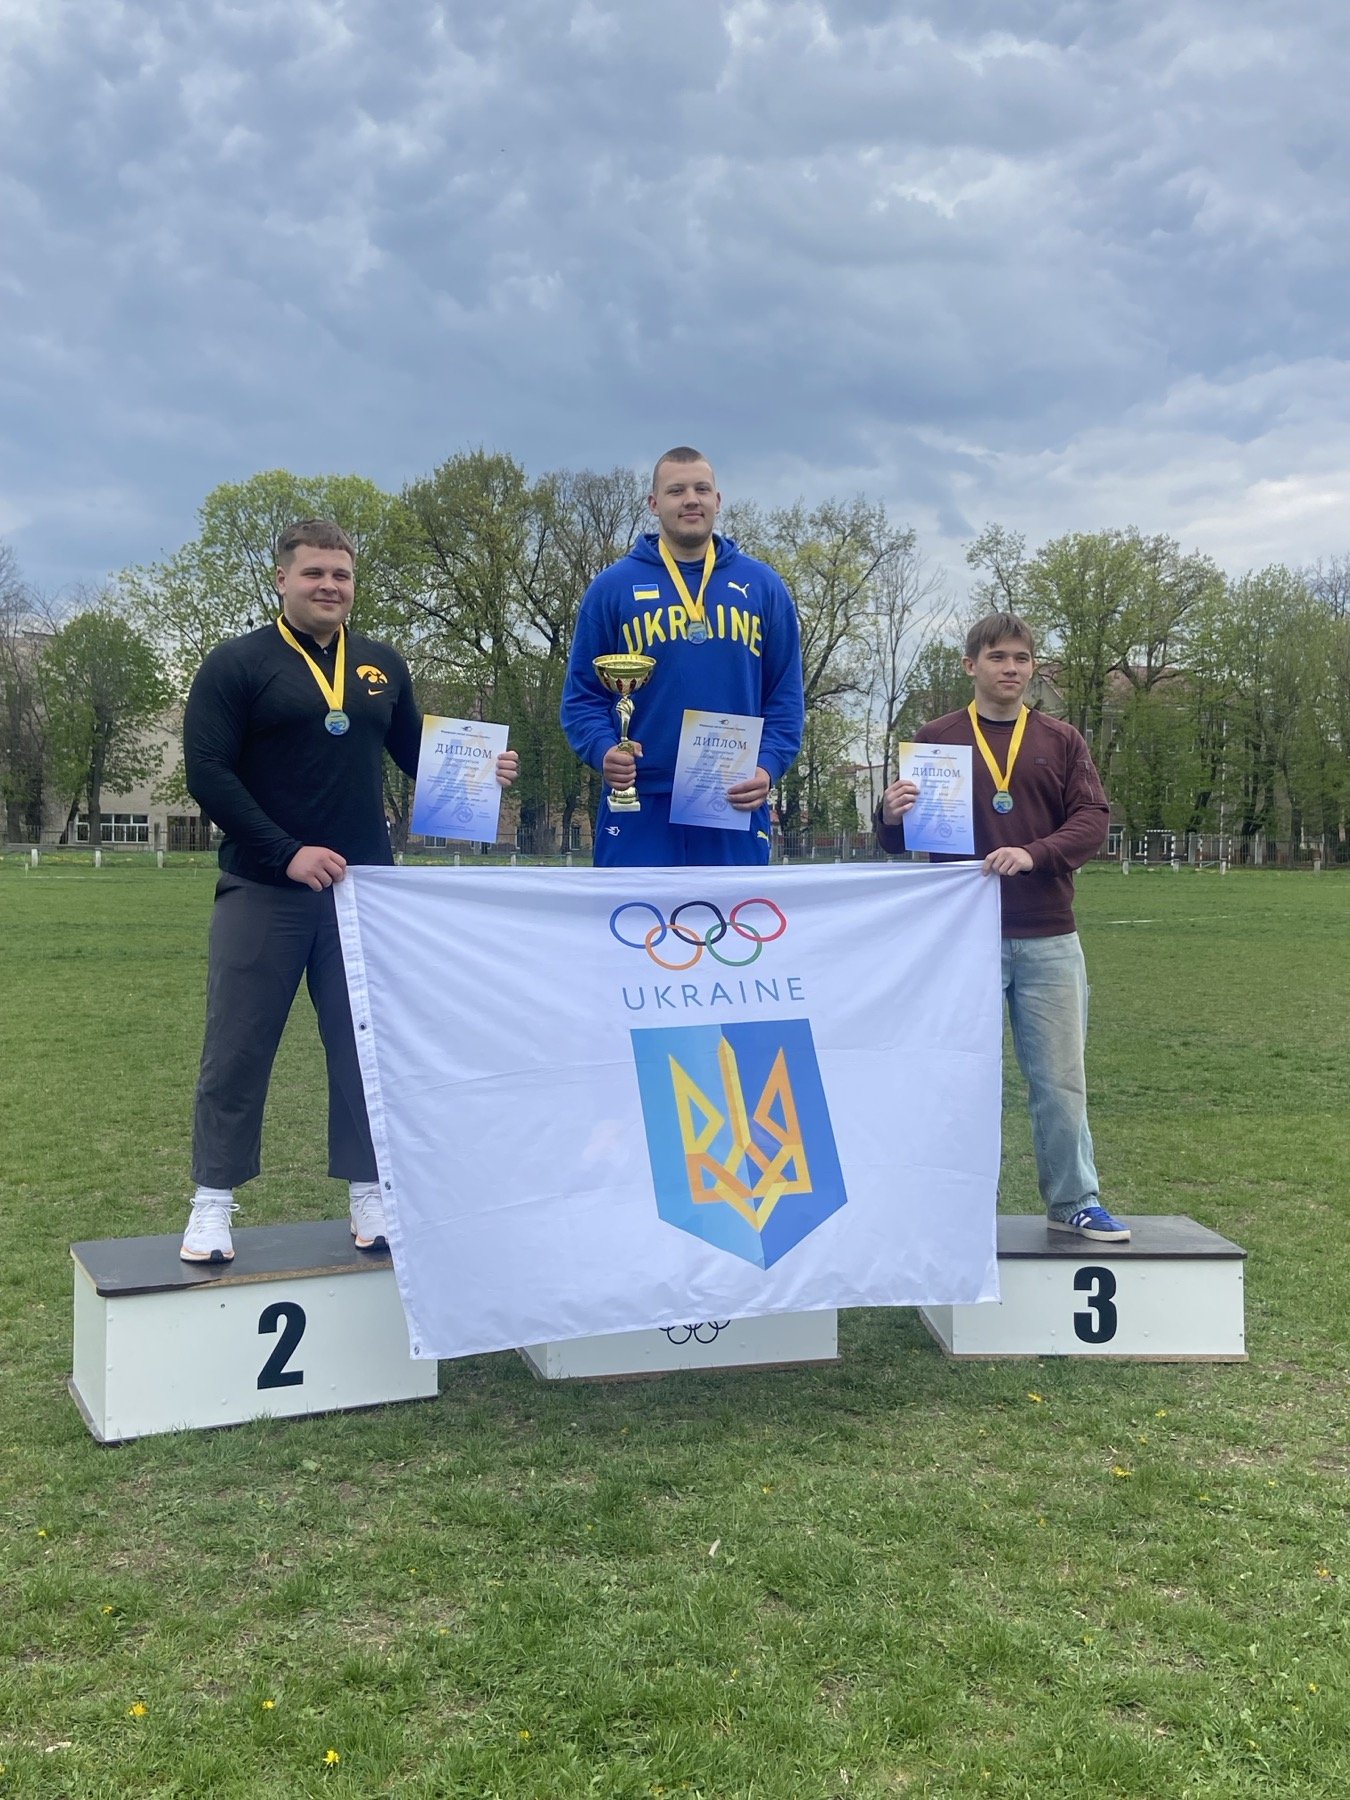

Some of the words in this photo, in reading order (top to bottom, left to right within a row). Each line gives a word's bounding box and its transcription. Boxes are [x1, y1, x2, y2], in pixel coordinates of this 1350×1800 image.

[622, 604, 762, 657] UKRINE
[435, 743, 492, 760] ДИПЛОМ
[693, 736, 748, 750] ДИПЛОМ
[912, 766, 961, 778] ДИПЛОМ
[622, 977, 806, 1011] UKRAINE
[1073, 1266, 1117, 1344] 3
[257, 1301, 307, 1390] 2
